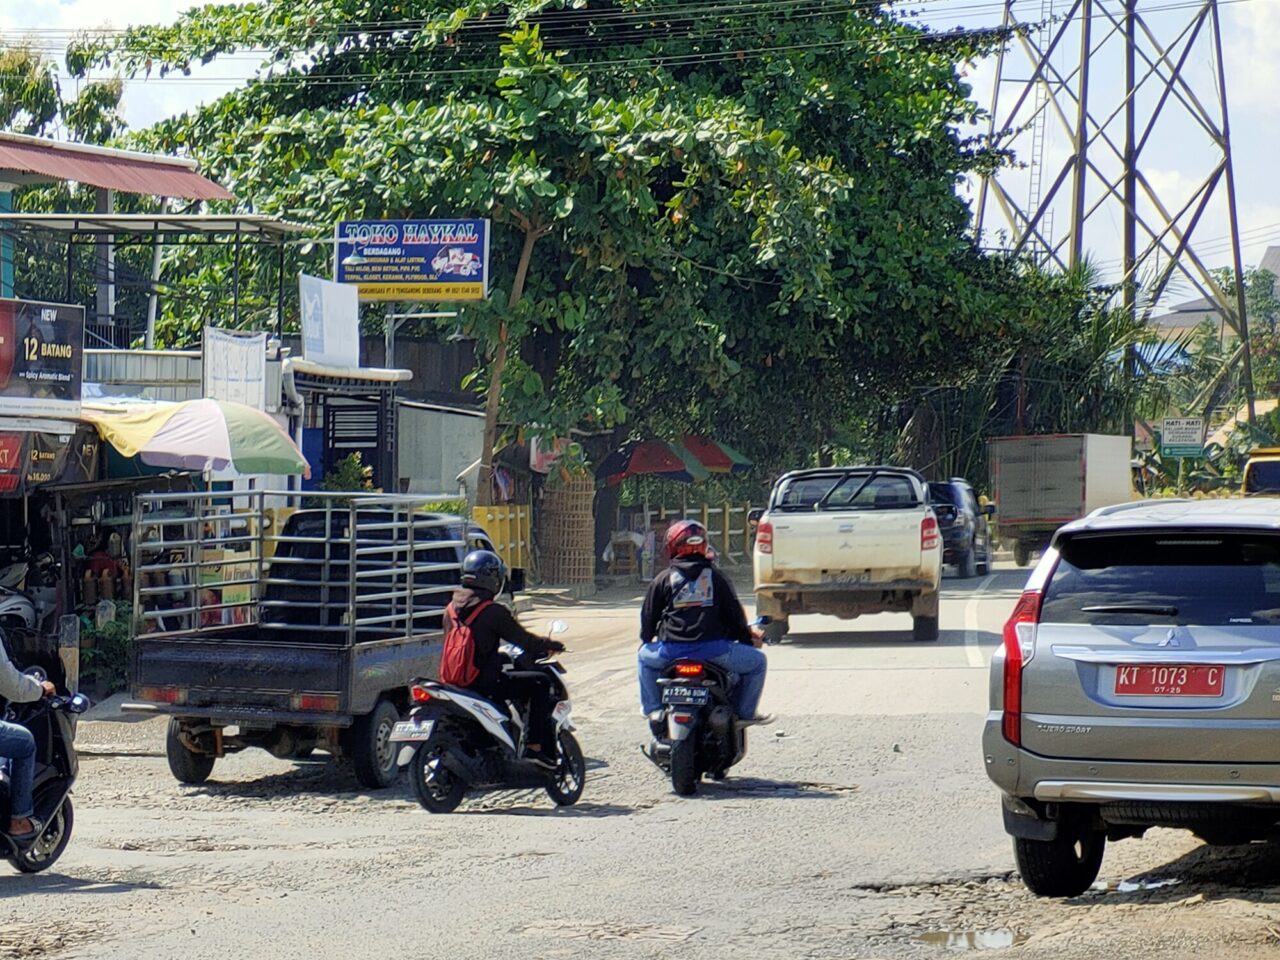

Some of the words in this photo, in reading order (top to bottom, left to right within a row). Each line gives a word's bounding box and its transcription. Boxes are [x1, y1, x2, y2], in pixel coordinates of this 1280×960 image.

[346, 223, 399, 245] TOKO
[402, 223, 478, 245] HAYKAL
[41, 308, 58, 322] NEW
[23, 337, 39, 361] 12
[41, 343, 72, 359] BATANG
[1120, 667, 1139, 685] KT
[1151, 667, 1188, 685] 1073
[1207, 668, 1218, 686] C
